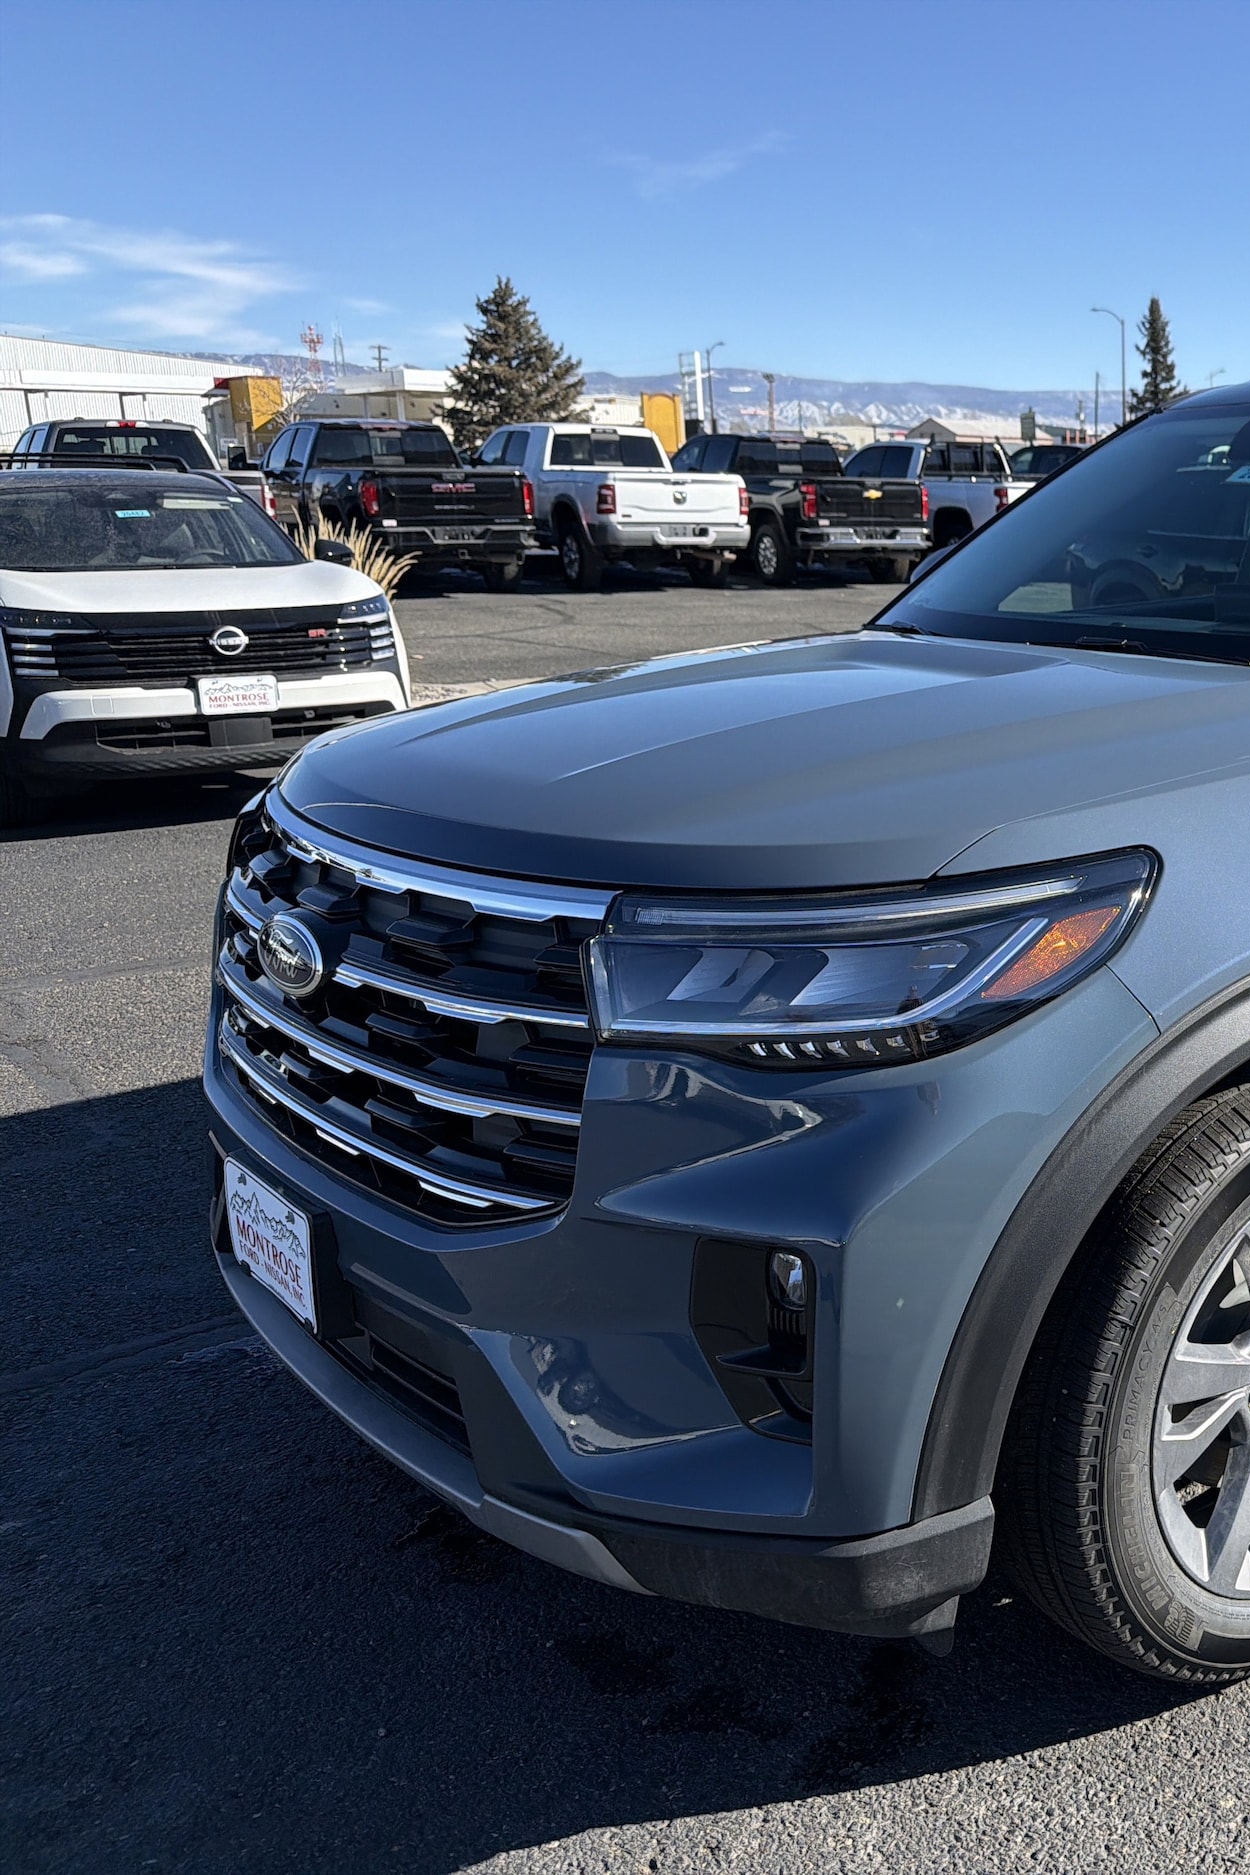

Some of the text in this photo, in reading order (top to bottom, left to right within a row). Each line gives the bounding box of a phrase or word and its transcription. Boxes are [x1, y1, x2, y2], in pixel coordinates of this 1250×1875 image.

[208, 692, 269, 703] MONTROSE
[236, 1214, 303, 1290] MONTROSE
[240, 1239, 260, 1266] FORD
[264, 1260, 293, 1298] NISSAN,
[292, 1284, 308, 1310] INC.
[1122, 1340, 1153, 1441] PRIMACY
[1120, 1471, 1170, 1612] MICHELIN
